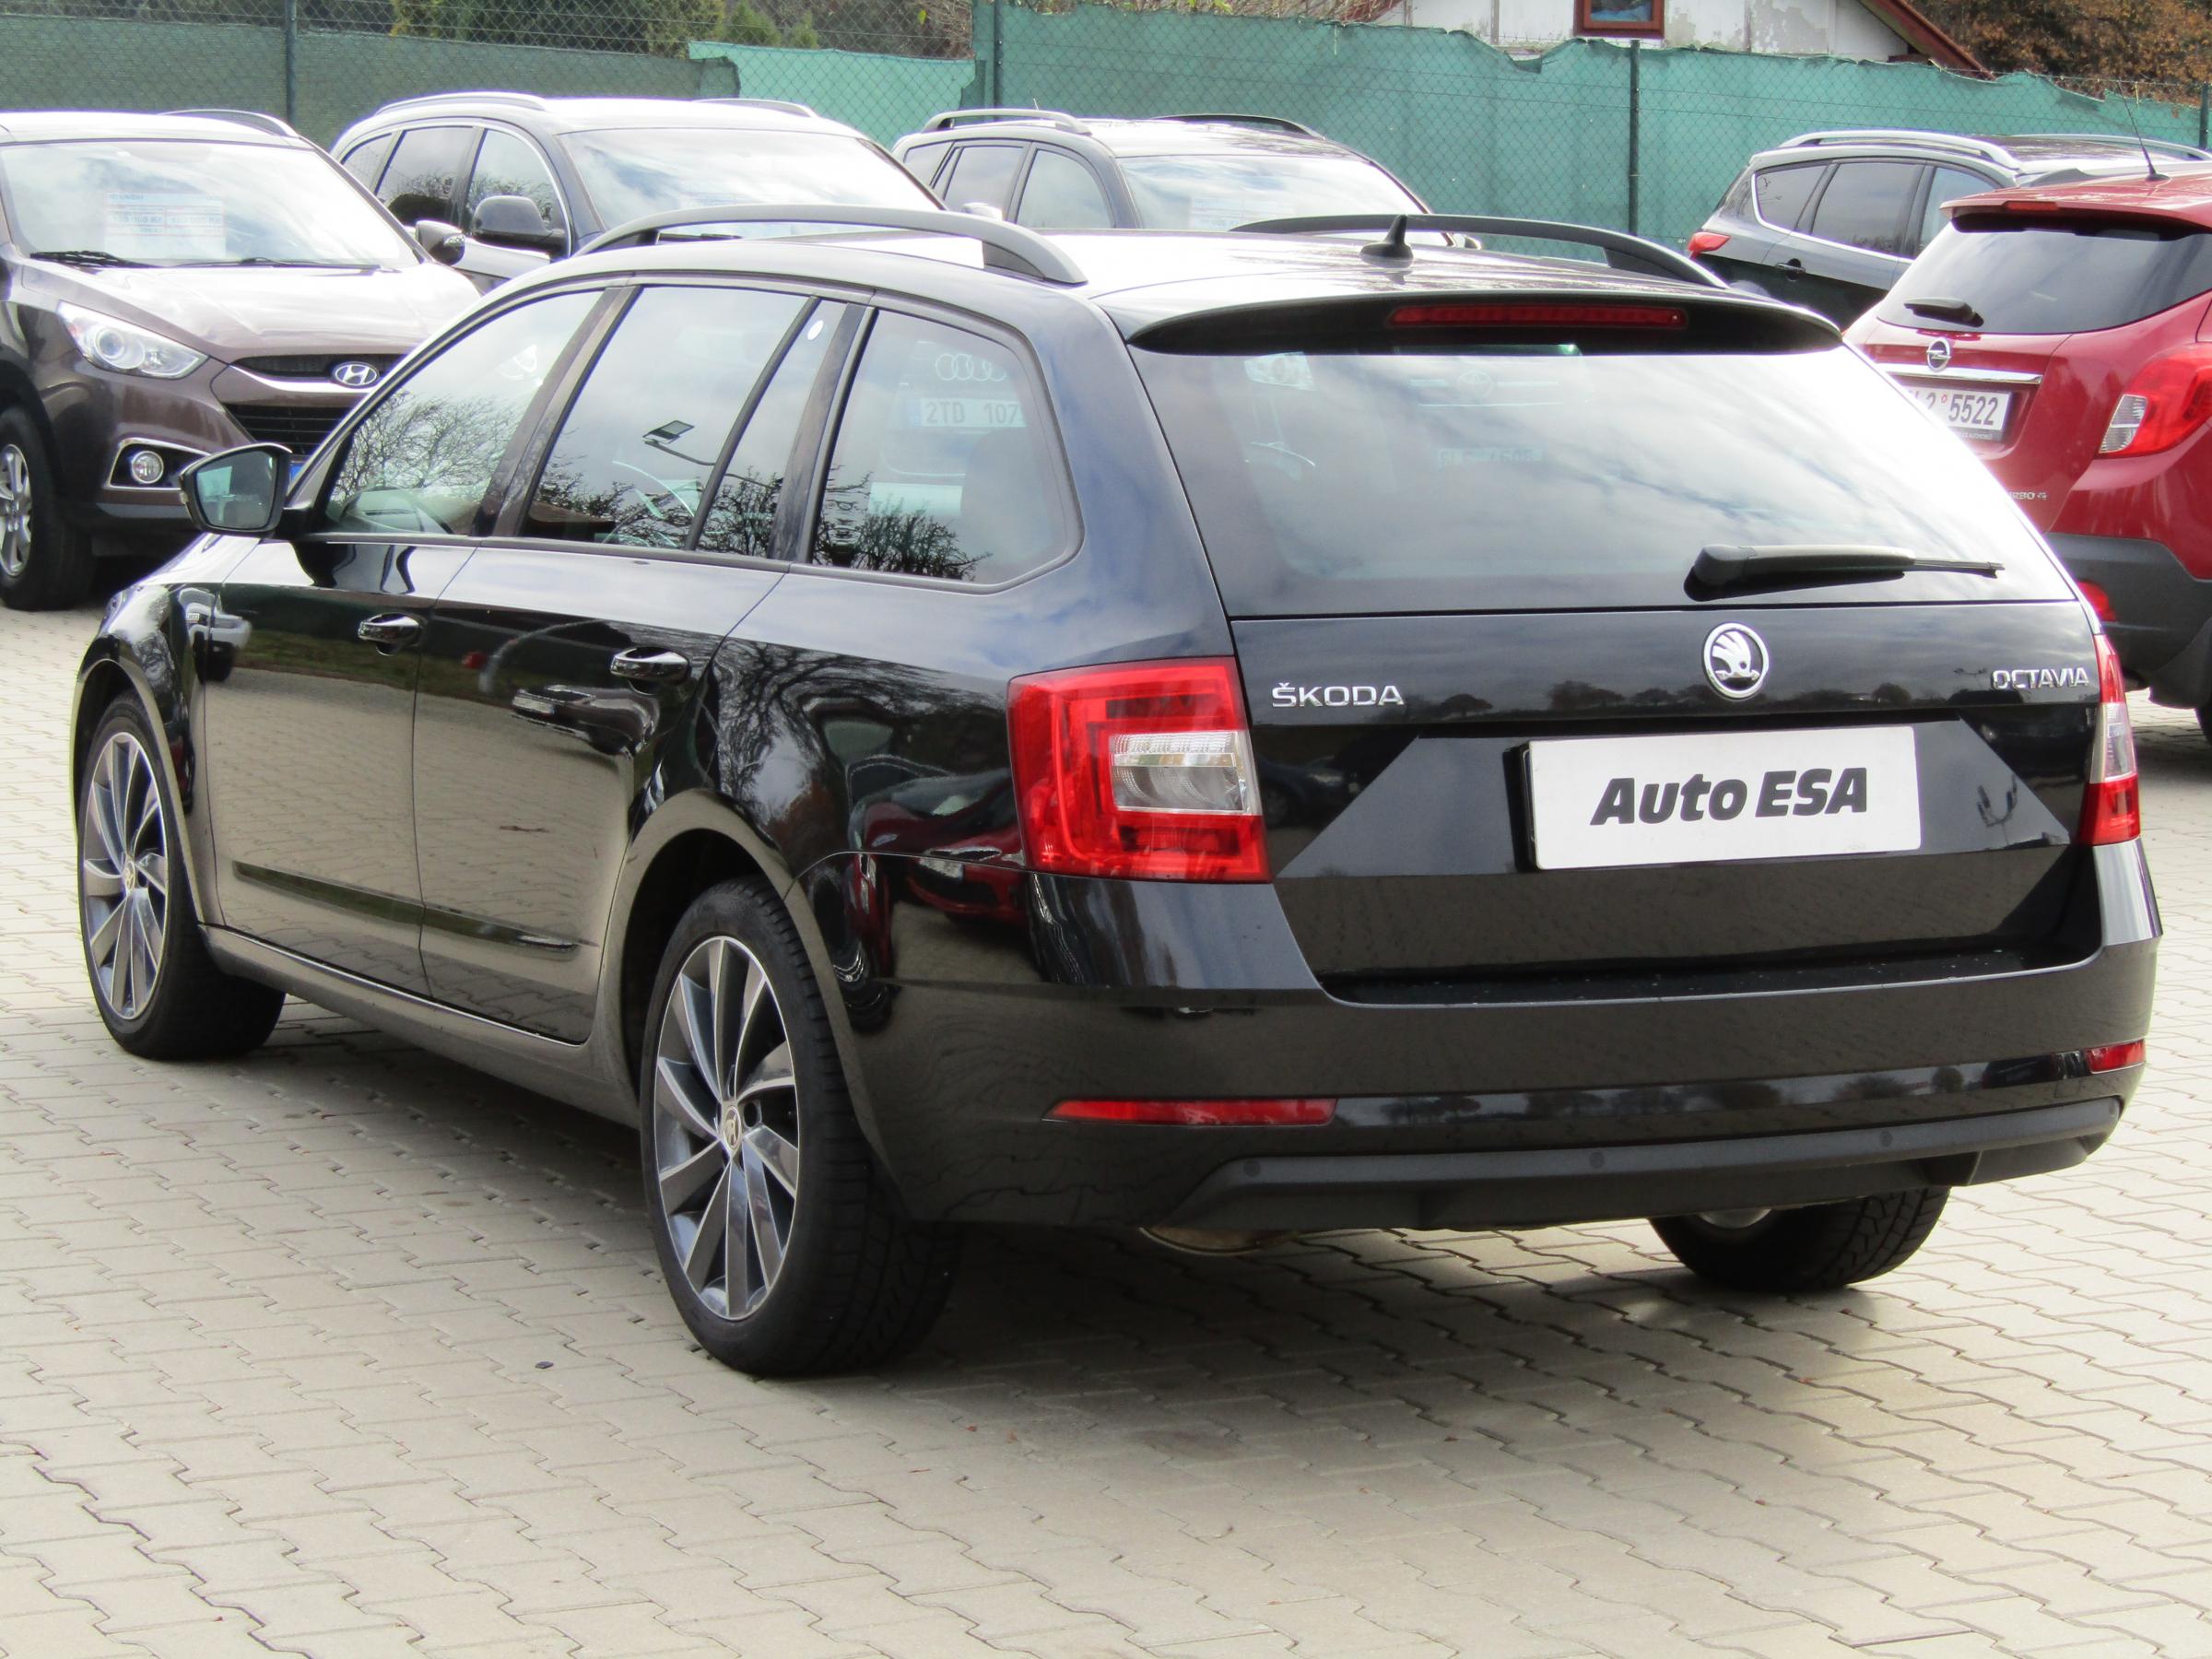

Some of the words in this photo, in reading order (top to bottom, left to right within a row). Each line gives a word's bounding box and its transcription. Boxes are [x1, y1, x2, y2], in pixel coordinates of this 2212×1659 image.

[924, 402, 966, 424] 2TD
[1948, 394, 1998, 425] 5522
[1992, 667, 2089, 689] OCTAVIA
[1272, 682, 1405, 707] ŠKODA
[1589, 773, 1747, 826] Auto
[1755, 767, 1867, 818] ESA
